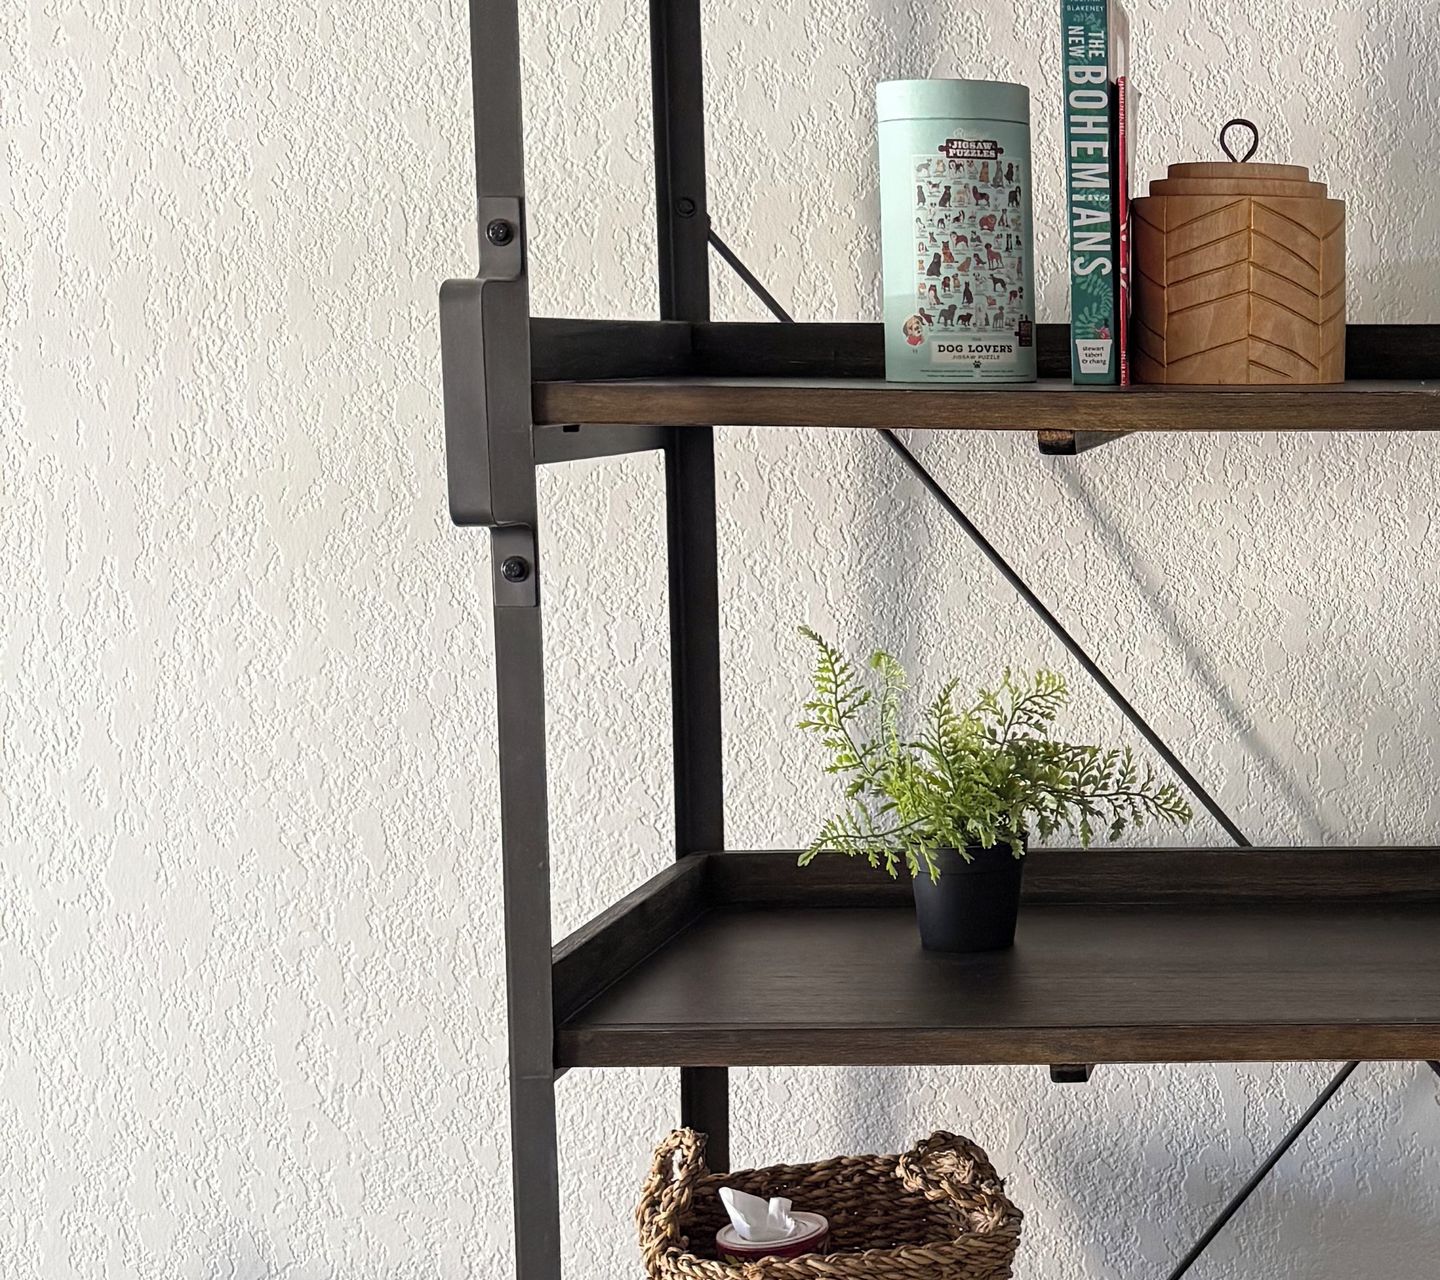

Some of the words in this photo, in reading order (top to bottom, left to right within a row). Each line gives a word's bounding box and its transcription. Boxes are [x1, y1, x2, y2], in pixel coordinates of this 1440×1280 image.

[1068, 25, 1085, 58] NEW
[1088, 30, 1105, 58] THE
[949, 149, 996, 158] PUZZLES
[952, 140, 992, 150] JIGSAW
[1068, 65, 1112, 276] BOHEMIANS
[938, 344, 963, 353] DOG
[968, 344, 1013, 353] LOVER'S
